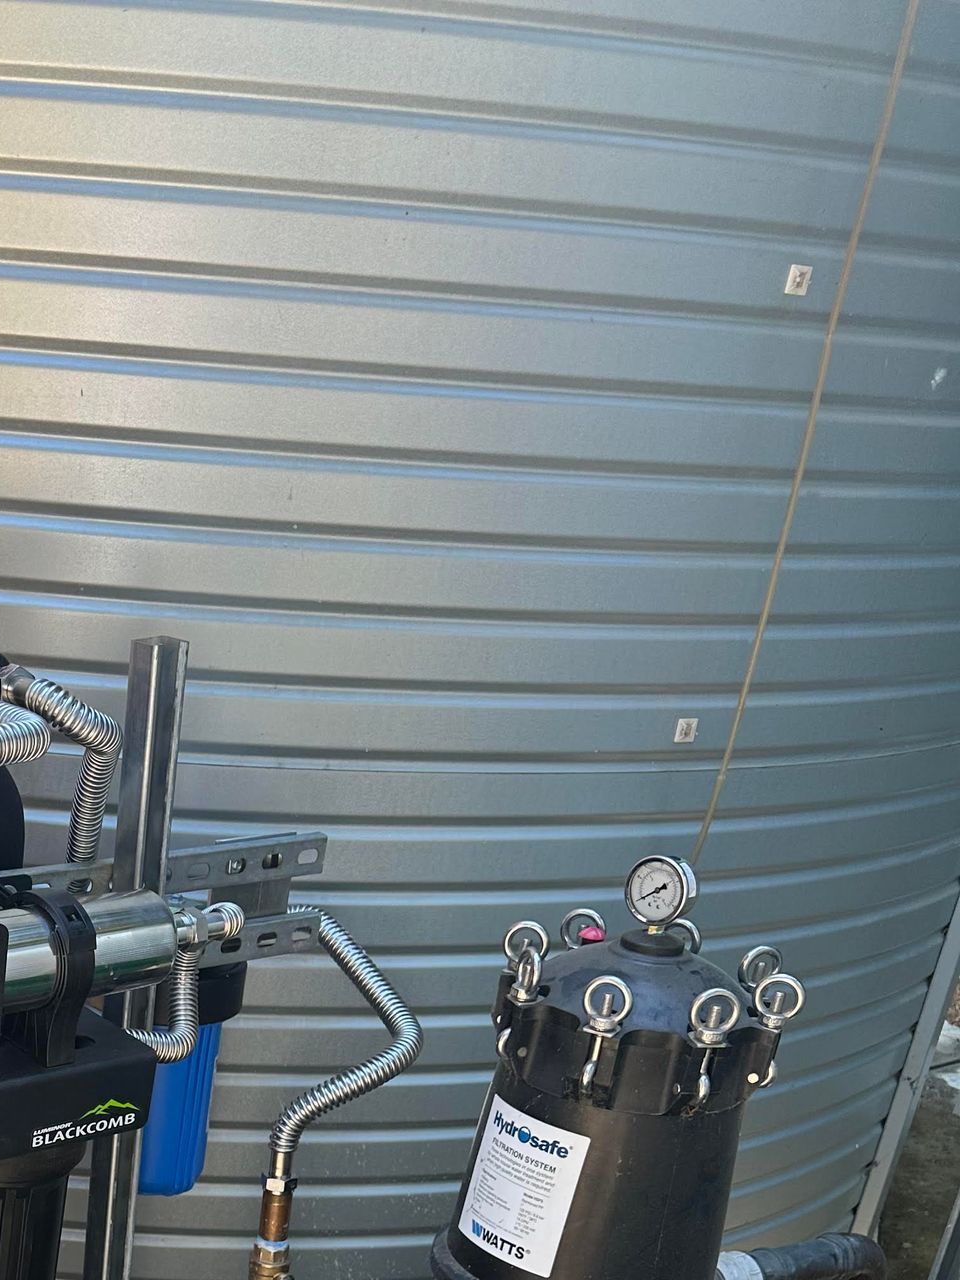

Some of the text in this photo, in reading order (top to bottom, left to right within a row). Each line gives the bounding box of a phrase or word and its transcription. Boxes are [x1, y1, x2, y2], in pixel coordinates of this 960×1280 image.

[32, 1113, 136, 1148] BLACKCOMB
[492, 1137, 557, 1174] FILTRATION SYSTEM
